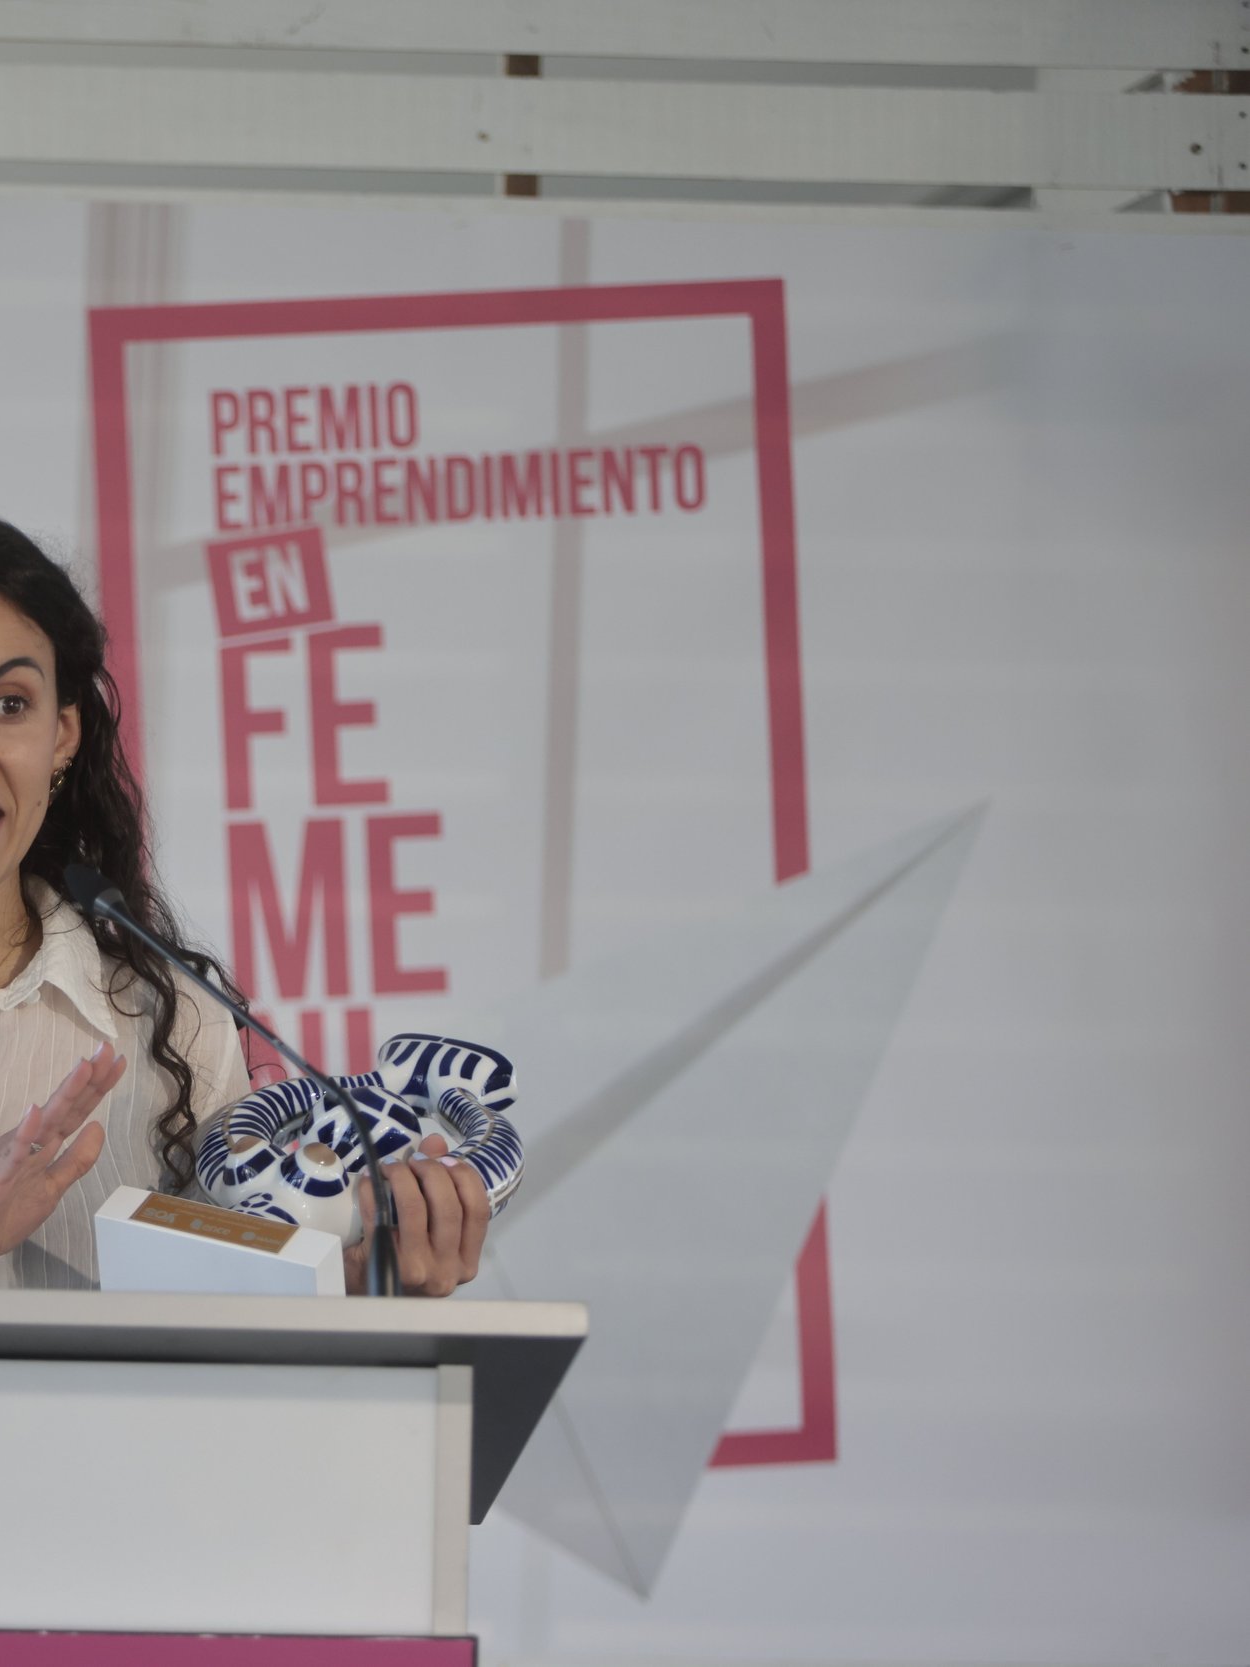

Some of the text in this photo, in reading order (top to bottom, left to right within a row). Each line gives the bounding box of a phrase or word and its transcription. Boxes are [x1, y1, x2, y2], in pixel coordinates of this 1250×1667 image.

[210, 380, 419, 456] PREMIO
[212, 443, 706, 533] EMPRENDIMIENTO
[230, 544, 310, 623] EN
